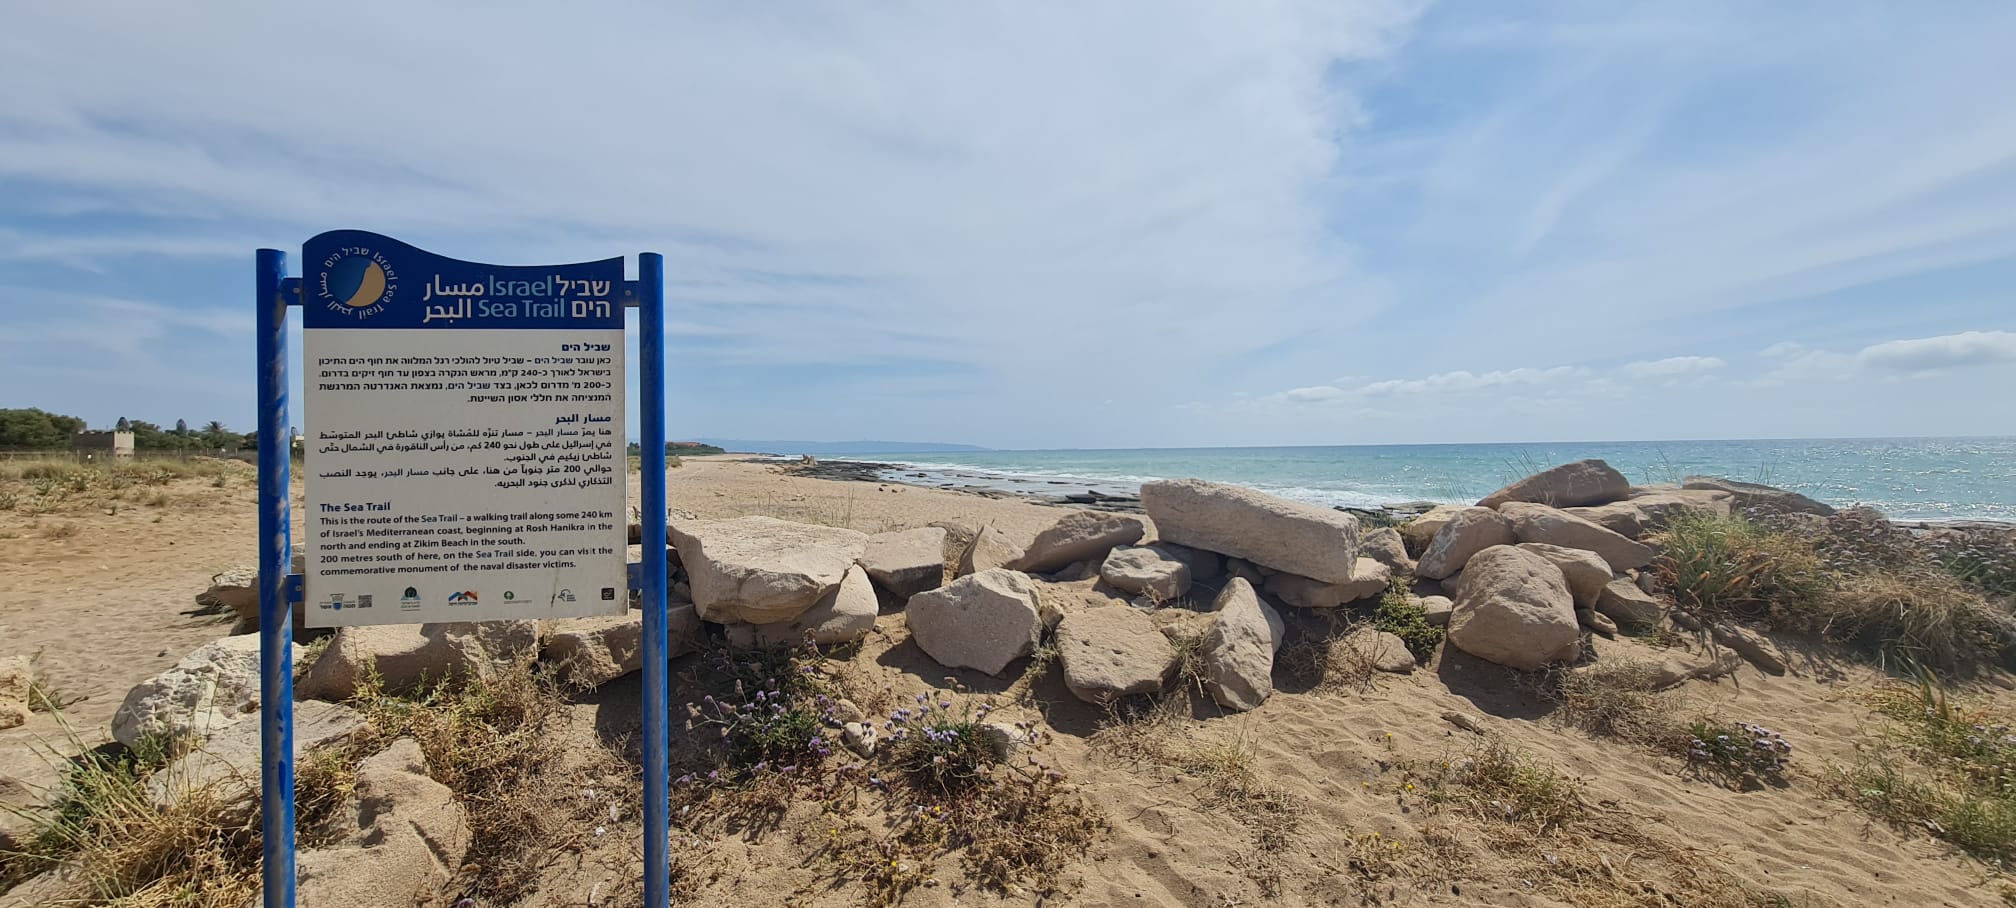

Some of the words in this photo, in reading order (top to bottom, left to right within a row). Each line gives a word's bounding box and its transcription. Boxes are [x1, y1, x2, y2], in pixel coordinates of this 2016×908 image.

[342, 247, 369, 256] שביל
[324, 253, 341, 268] הים
[373, 252, 398, 280] Israel
[423, 274, 485, 300] مسار
[489, 275, 552, 296] Israel
[555, 275, 611, 296] שביל
[318, 272, 333, 298] مسار
[327, 300, 353, 315] البحر
[382, 284, 397, 303] Sea
[359, 303, 384, 320] Trail
[423, 299, 472, 324] البحر
[478, 301, 517, 318] Sea
[525, 299, 565, 318] Trail
[571, 300, 611, 318] הים
[584, 343, 610, 351] שביל
[318, 358, 347, 366] התיכון
[367, 358, 383, 366] חוף
[401, 356, 432, 365] המלווה
[434, 356, 450, 365] רגל
[452, 356, 480, 365] להולכי
[502, 356, 524, 364] שביל
[378, 370, 394, 378] חוף
[412, 370, 436, 378] בצפון
[438, 370, 468, 378] הנקרה
[551, 369, 575, 377] לאורך
[445, 383, 464, 391] הים,
[467, 381, 490, 389] שביל
[514, 381, 538, 390] לכאן,
[467, 395, 505, 403] השייטת.
[508, 395, 527, 404] אסון
[530, 393, 552, 402] חללי
[555, 394, 568, 402] את
[571, 394, 611, 402] המנציחה
[555, 414, 579, 425] البحر
[583, 414, 611, 424] مسار
[364, 430, 383, 440] البحر
[501, 429, 523, 438] مسار
[535, 428, 553, 437] البحر
[556, 428, 578, 437] مسار
[599, 427, 612, 435] هنا
[421, 431, 445, 441] يوازي
[341, 443, 374, 453] الشمال
[376, 445, 394, 454] في
[395, 442, 428, 452] الناقورة
[430, 440, 449, 451] رأس
[451, 443, 464, 451] من
[484, 441, 501, 449] 240
[503, 441, 517, 450] نحو
[519, 441, 539, 450] طول
[541, 441, 560, 450] على
[562, 440, 594, 450] إسرائيل
[596, 441, 612, 450] في
[504, 453, 536, 462] الجنوب.
[539, 454, 555, 464] في
[557, 453, 580, 463] زيكيم
[406, 469, 429, 477] مسار
[432, 467, 455, 477] جانب
[458, 468, 479, 477] على
[503, 466, 518, 476] من
[546, 465, 560, 475] متر
[564, 465, 580, 473] 200
[584, 465, 612, 476] حوالي
[319, 469, 351, 479] النصب
[355, 471, 377, 479] يوجد
[528, 479, 548, 488] جنود
[551, 477, 576, 488] لذكرى
[578, 476, 612, 489] التذكاري
[320, 503, 341, 512] The
[344, 503, 364, 512] Sea
[366, 501, 390, 511] Trail
[320, 517, 339, 525] This
[341, 517, 348, 525] is
[350, 517, 364, 525] the
[393, 515, 403, 523] of
[404, 515, 419, 523] the
[421, 515, 437, 523] Sea
[439, 514, 457, 522] Trail
[473, 513, 508, 522] walking
[510, 512, 527, 520] trail
[529, 512, 554, 521] along
[599, 510, 613, 519] km
[320, 530, 330, 538] of
[332, 529, 364, 537] Israel's
[366, 528, 434, 536] Mediterranean
[437, 527, 463, 535] coast,
[466, 526, 512, 535] beginning
[515, 525, 524, 533] at
[526, 524, 548, 532] Rosh
[550, 523, 584, 532] Hanikra
[587, 523, 595, 531] in
[598, 522, 613, 530] the
[320, 542, 346, 551] north
[348, 541, 366, 550] and
[368, 541, 400, 550] ending
[414, 539, 439, 548] Zikim
[441, 538, 468, 547] Beach
[470, 538, 479, 546] in
[481, 538, 496, 546] the
[498, 537, 525, 546] south.
[320, 555, 338, 564] 200
[340, 555, 373, 563] metres
[376, 552, 402, 561] south
[405, 552, 415, 560] of
[418, 552, 440, 560] here,
[458, 551, 473, 559] the
[476, 550, 492, 558] Sea
[494, 549, 513, 558] Trail
[516, 549, 537, 558] side,
[539, 550, 556, 558] you
[577, 547, 595, 555] visit
[598, 546, 613, 555] the
[320, 566, 396, 576] commemorative
[398, 564, 448, 573] monument
[450, 563, 460, 572] of
[463, 563, 478, 571] the
[480, 562, 504, 570] naval
[543, 560, 576, 569] victims.
